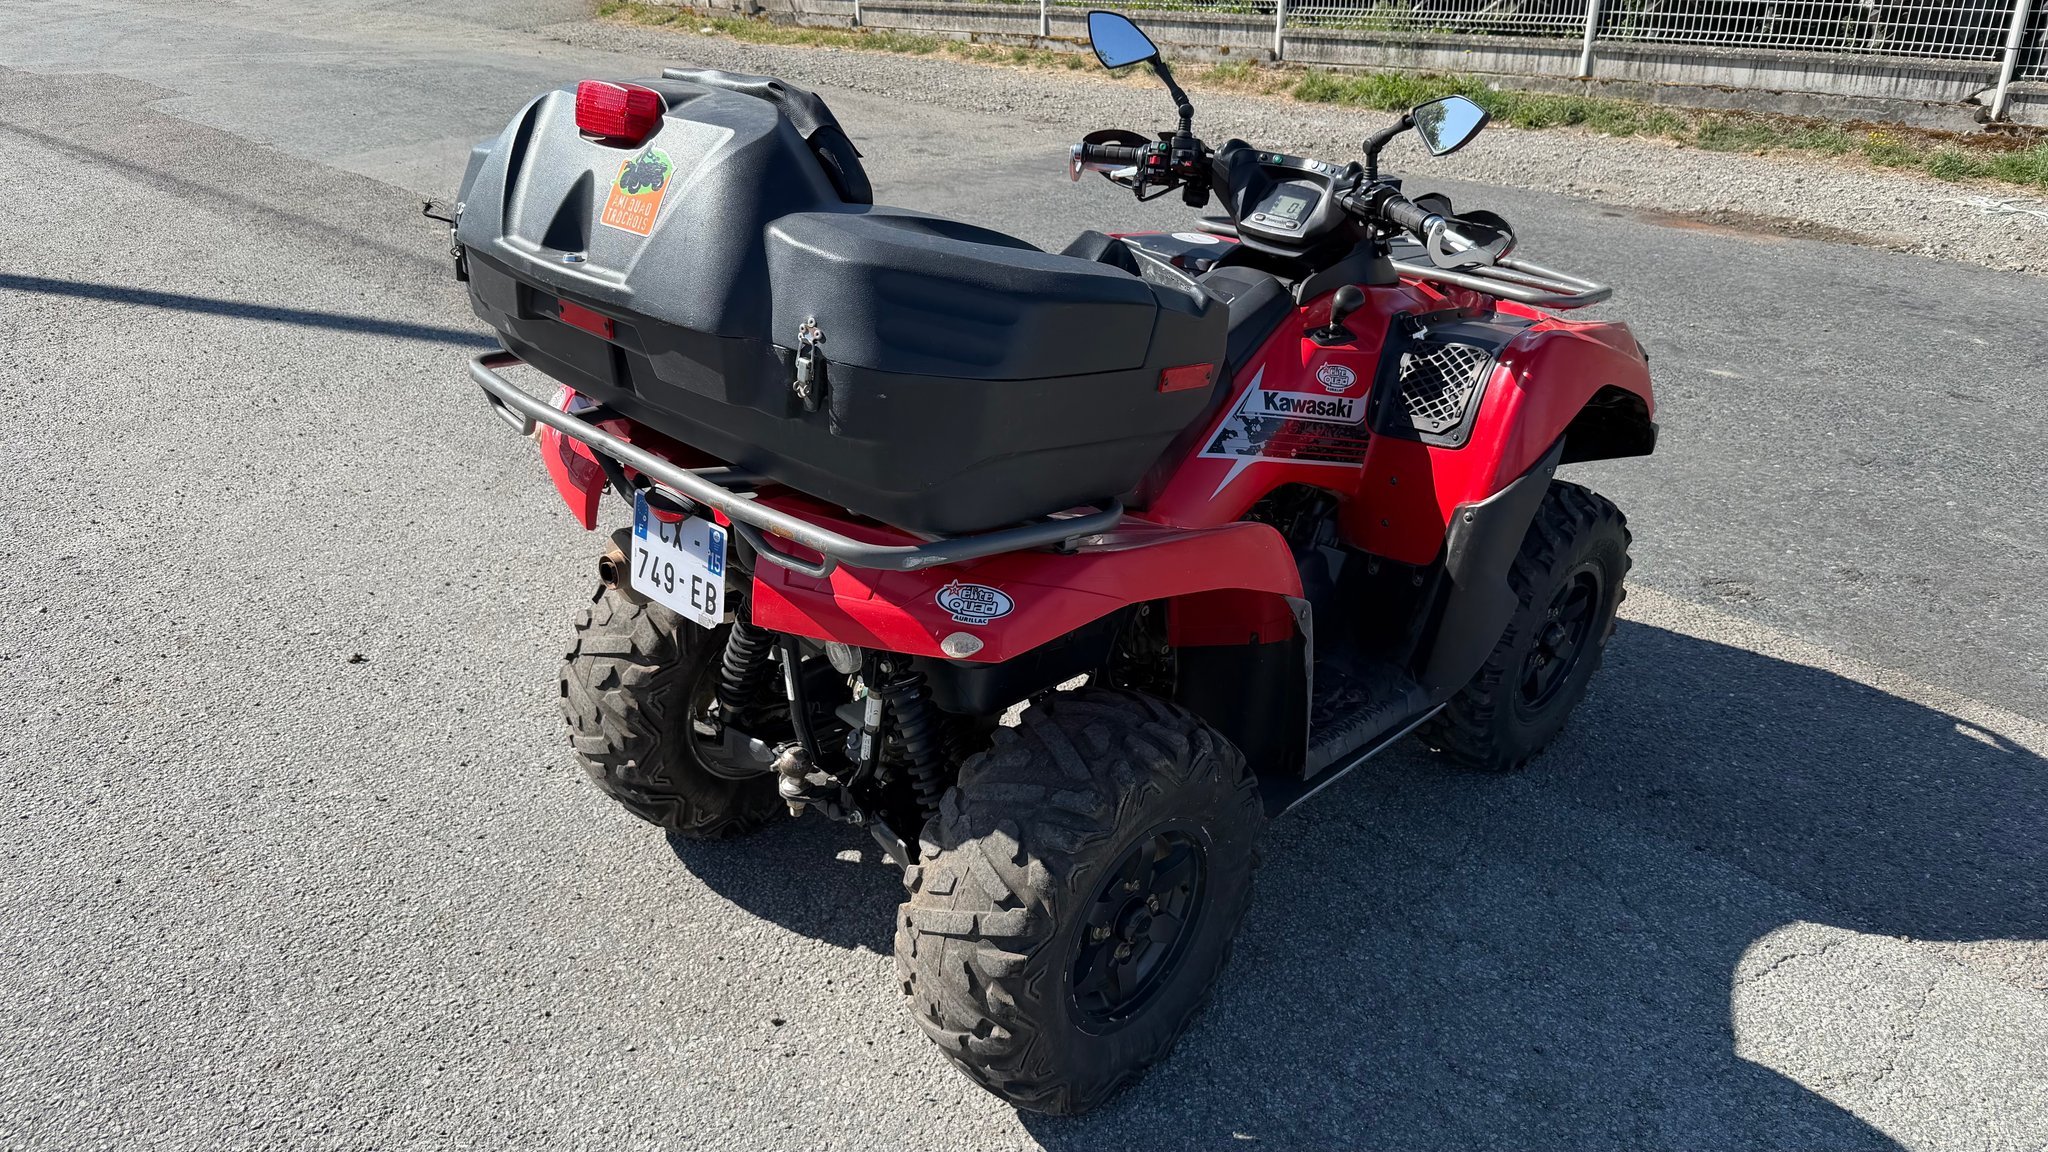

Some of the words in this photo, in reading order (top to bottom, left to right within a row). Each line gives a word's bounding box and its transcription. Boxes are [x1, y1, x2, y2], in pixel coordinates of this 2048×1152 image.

[606, 207, 649, 230] TROCHOIS
[1286, 202, 1299, 213] 0
[1263, 391, 1353, 418] Kawasaki
[709, 552, 721, 573] 15
[638, 547, 717, 615] 749-EB
[953, 614, 987, 624] AURILLAC
